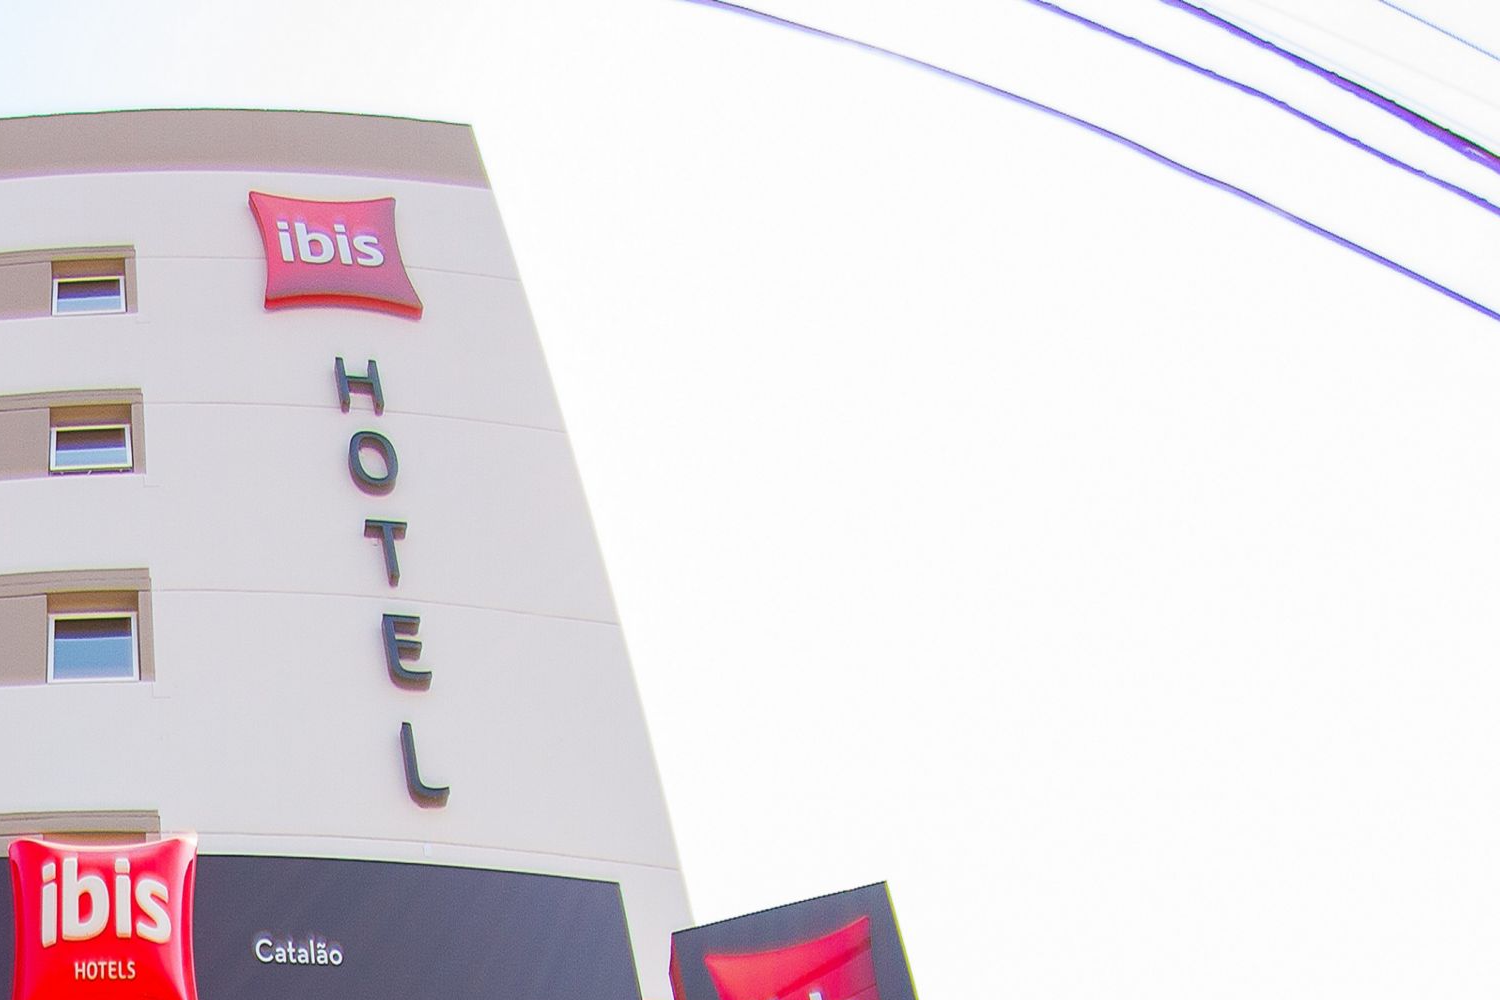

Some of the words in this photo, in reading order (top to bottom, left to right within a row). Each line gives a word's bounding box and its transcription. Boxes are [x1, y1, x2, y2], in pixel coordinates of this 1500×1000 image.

[276, 220, 385, 267] ibis
[333, 356, 450, 809] HOTEL
[41, 856, 172, 949] ibis
[74, 960, 136, 981] HOTELS
[254, 937, 344, 966] Catalão
